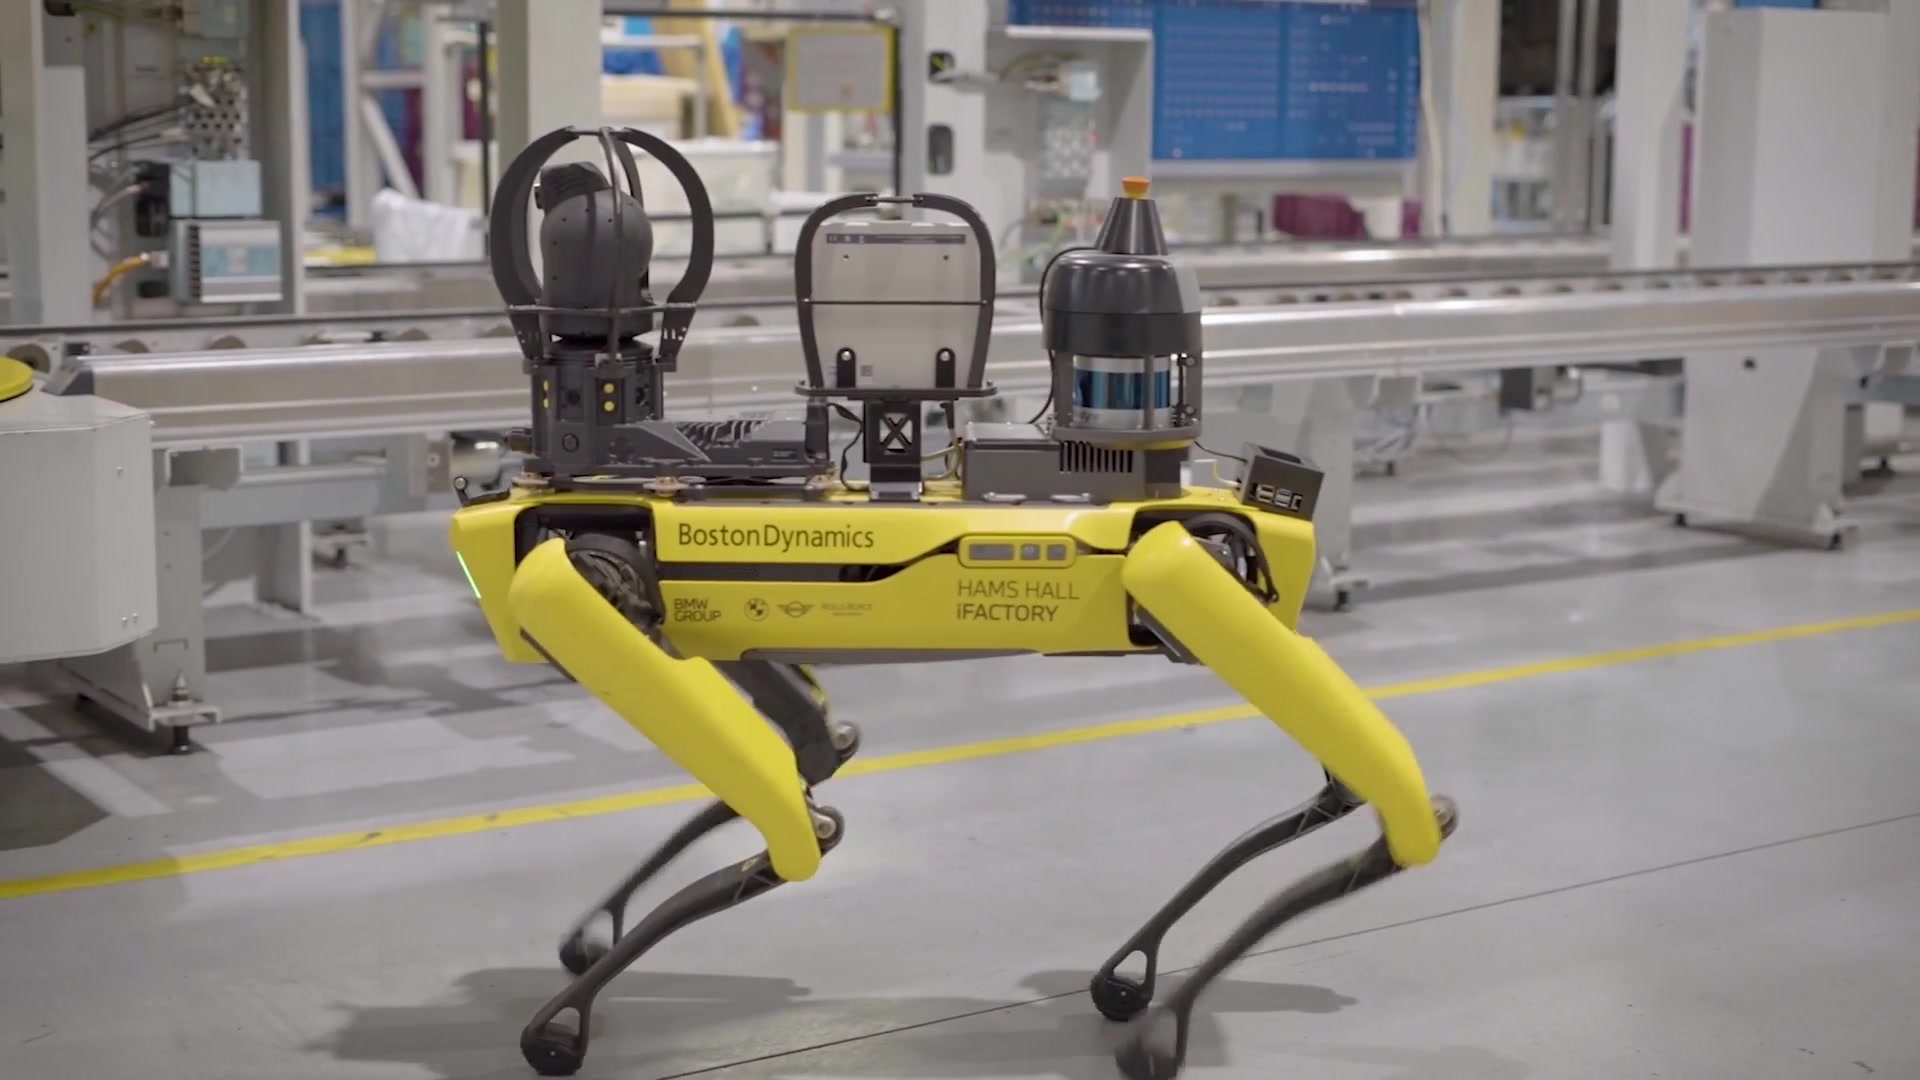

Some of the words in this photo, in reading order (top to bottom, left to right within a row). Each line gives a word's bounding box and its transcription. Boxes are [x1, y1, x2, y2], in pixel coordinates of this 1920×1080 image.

[957, 579, 1019, 599] HAMS
[1025, 581, 1080, 600] HALL
[674, 598, 708, 610] BMW
[956, 602, 1059, 622] iFACTORY
[674, 610, 722, 622] GROUP
